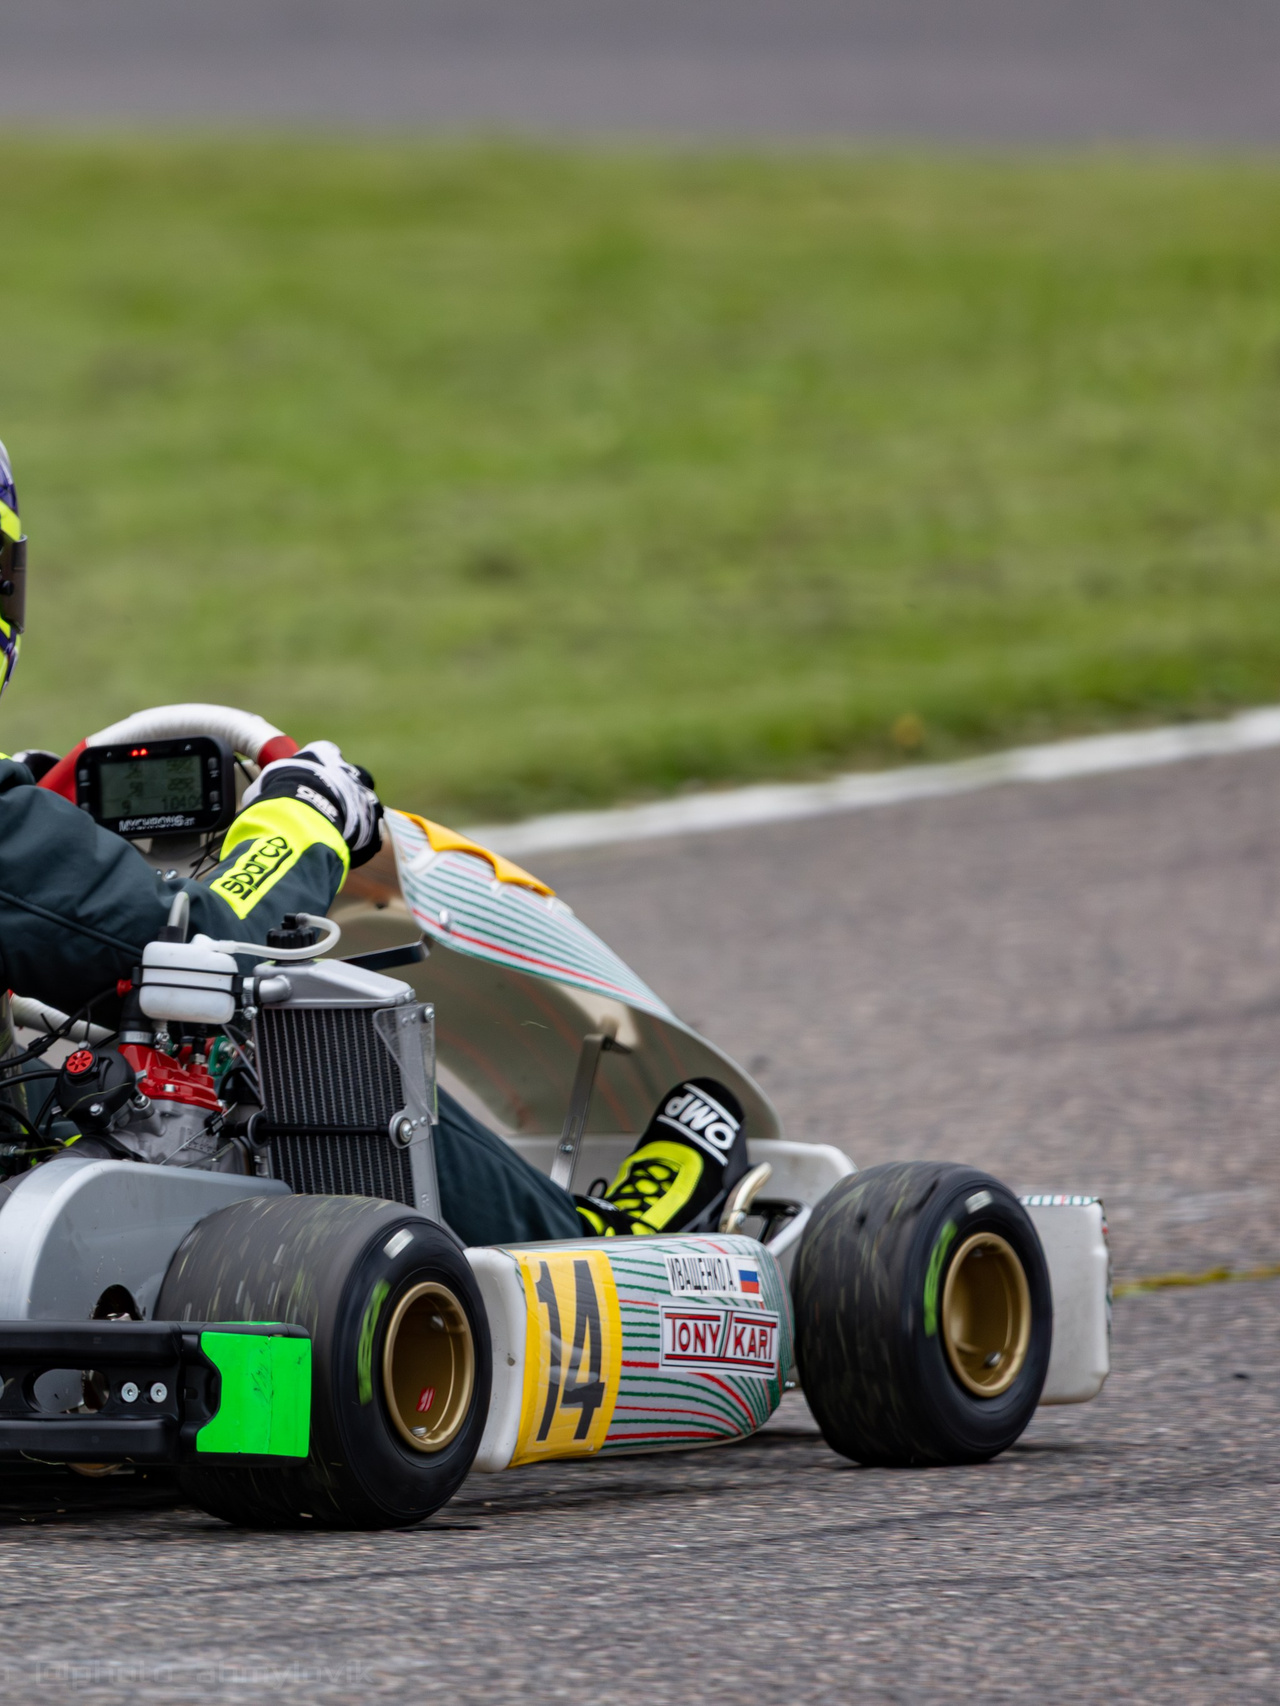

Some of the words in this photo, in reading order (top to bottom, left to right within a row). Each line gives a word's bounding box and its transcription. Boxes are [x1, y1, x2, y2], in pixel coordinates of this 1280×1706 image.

[664, 1092, 736, 1150] OMP
[535, 1260, 605, 1441] 14
[664, 1313, 720, 1354] TONY
[733, 1317, 777, 1360] KART
